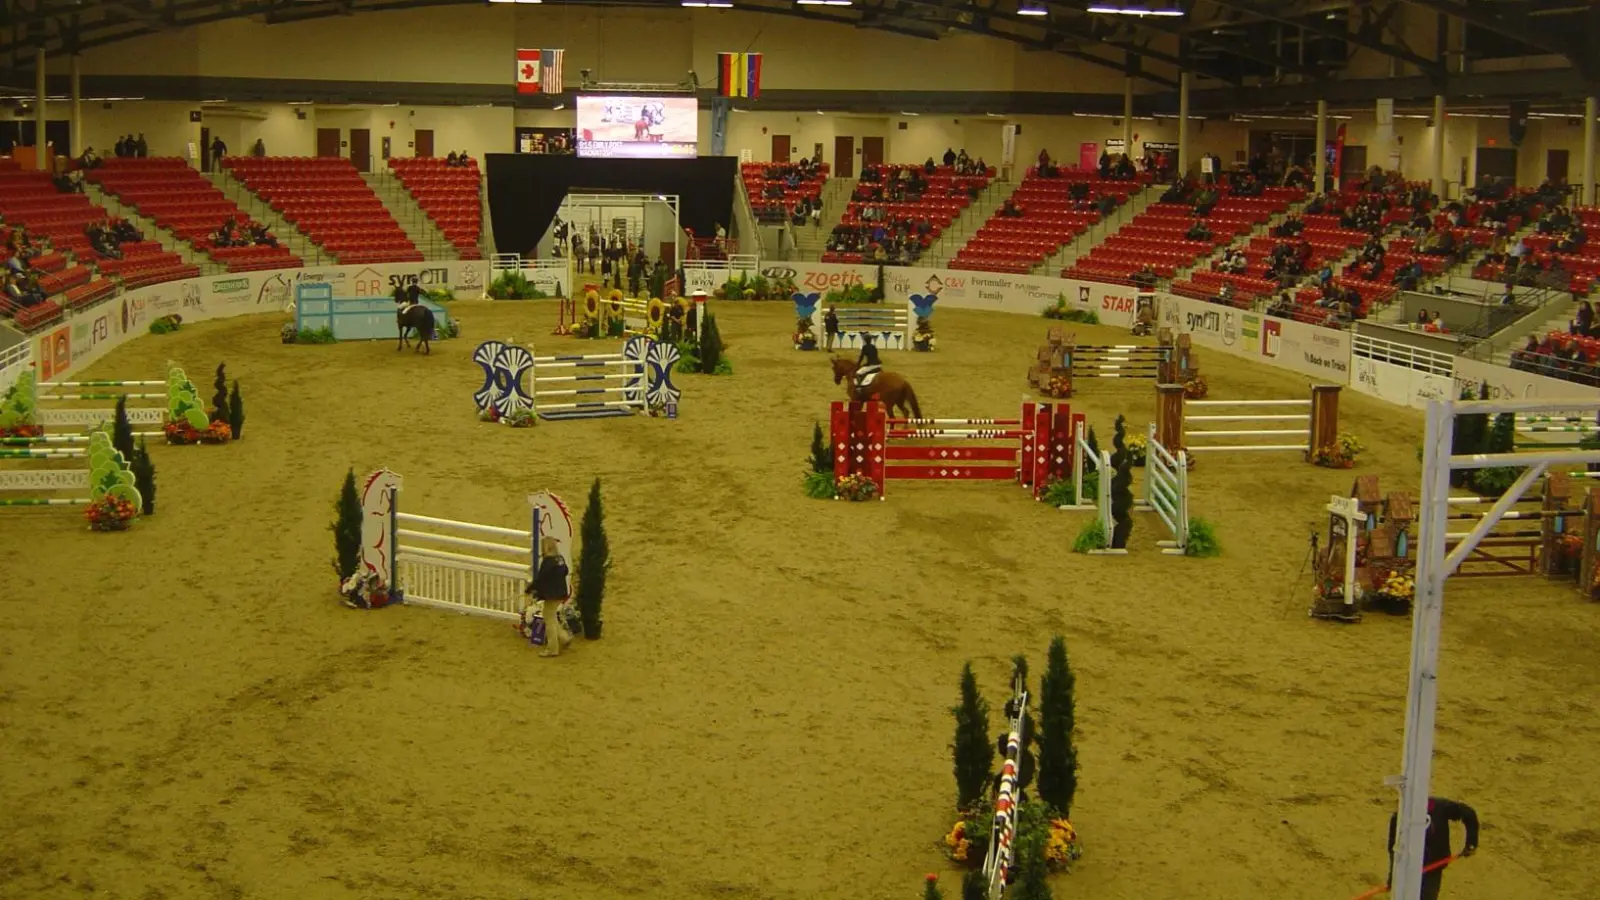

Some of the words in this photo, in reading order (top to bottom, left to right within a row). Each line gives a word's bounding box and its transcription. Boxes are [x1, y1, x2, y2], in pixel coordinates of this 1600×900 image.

[303, 272, 324, 281] Energy
[804, 269, 863, 290] zoetis
[944, 277, 965, 289] C&V
[978, 290, 1004, 303] Family
[1310, 352, 1322, 366] Back
[1331, 359, 1346, 373] Track
